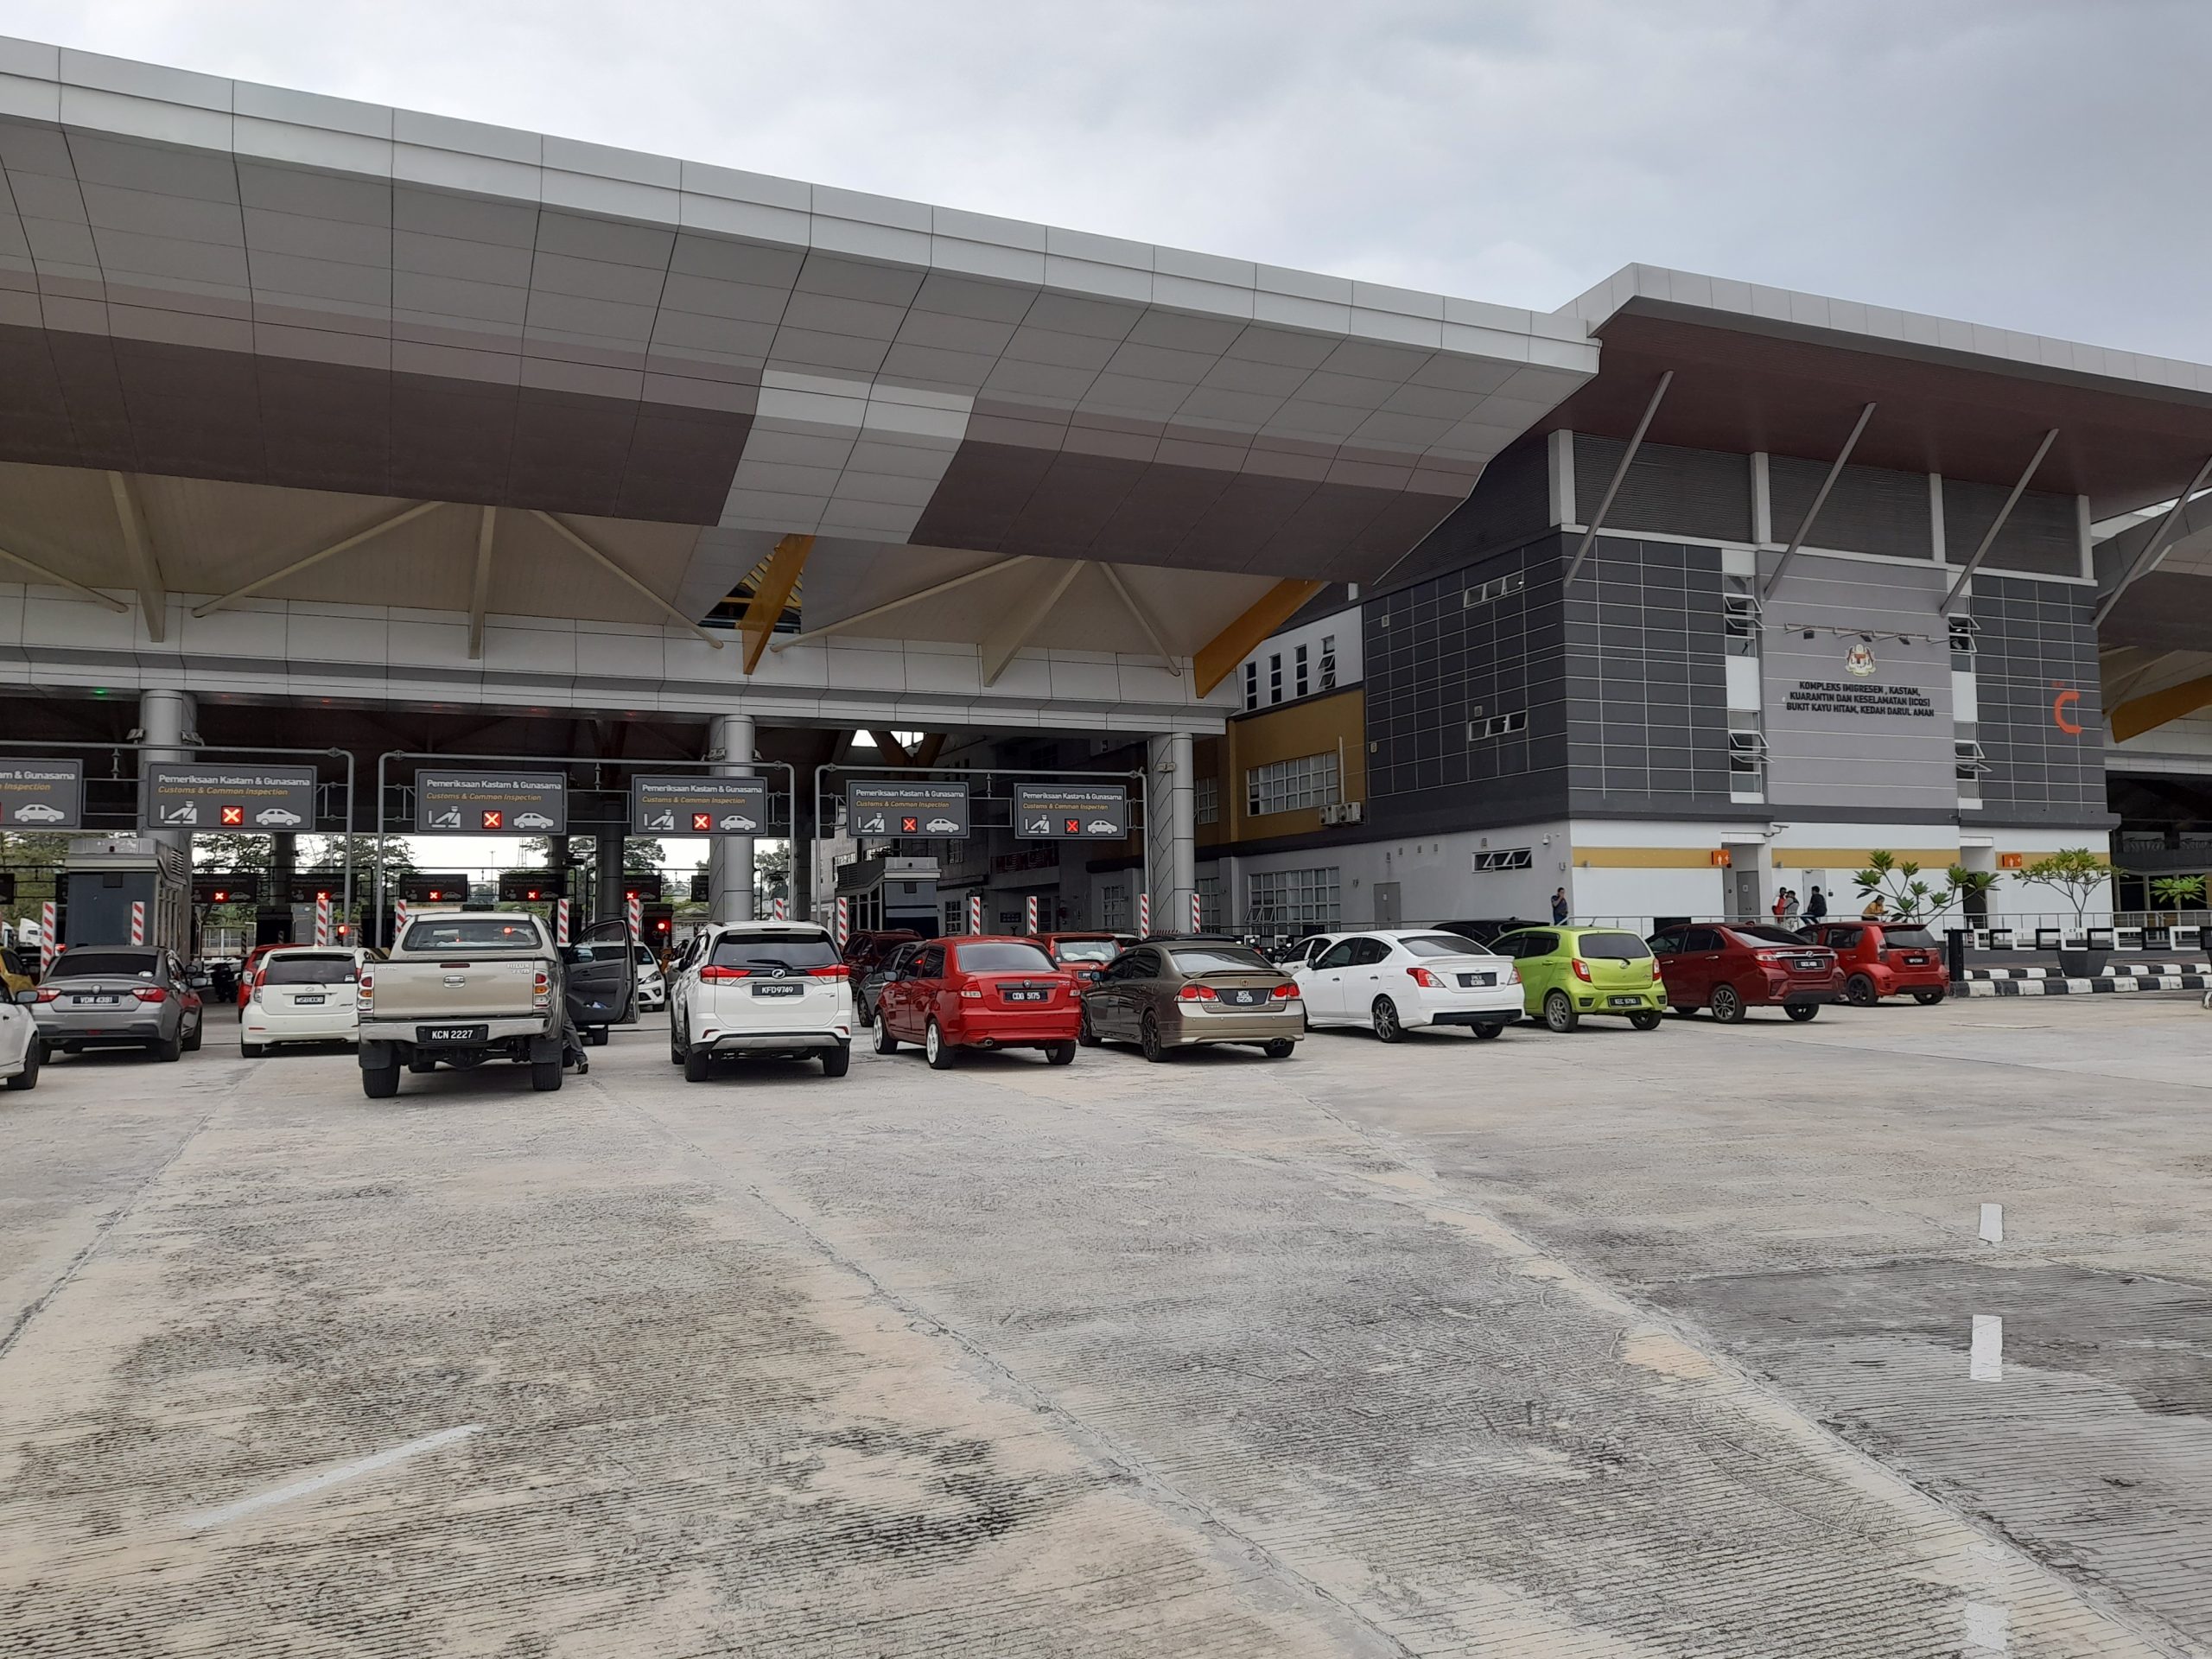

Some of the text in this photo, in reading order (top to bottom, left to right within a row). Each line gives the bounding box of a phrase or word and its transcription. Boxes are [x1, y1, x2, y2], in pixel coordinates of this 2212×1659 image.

[1799, 681, 1841, 692] KOMPLEKS
[1842, 683, 1884, 694] IMIGRESEN
[1889, 686, 1921, 696] KASTAM,
[1789, 691, 1835, 702] KUARANTIN
[1836, 694, 1853, 702] DAN
[1853, 695, 1907, 705] KESELAMATAN
[1786, 702, 1810, 711] BUKIT
[1811, 703, 1832, 712] KAYU
[1860, 705, 1885, 715] KEDAH
[1887, 707, 1912, 716] DARUL
[1913, 709, 1935, 717] AMAN
[14, 770, 23, 779] &
[23, 770, 76, 780] Gunasama
[158, 774, 310, 786] Pemeriksaan Kastam & Gunasama
[4, 783, 52, 791] Inspection
[427, 779, 480, 788] Pemeriksaan
[481, 780, 512, 789] Kastam
[520, 781, 562, 790] Gunasama
[725, 785, 763, 794] Gunasama
[504, 793, 542, 802] Inspection
[431, 1029, 474, 1039] KCN 2227
